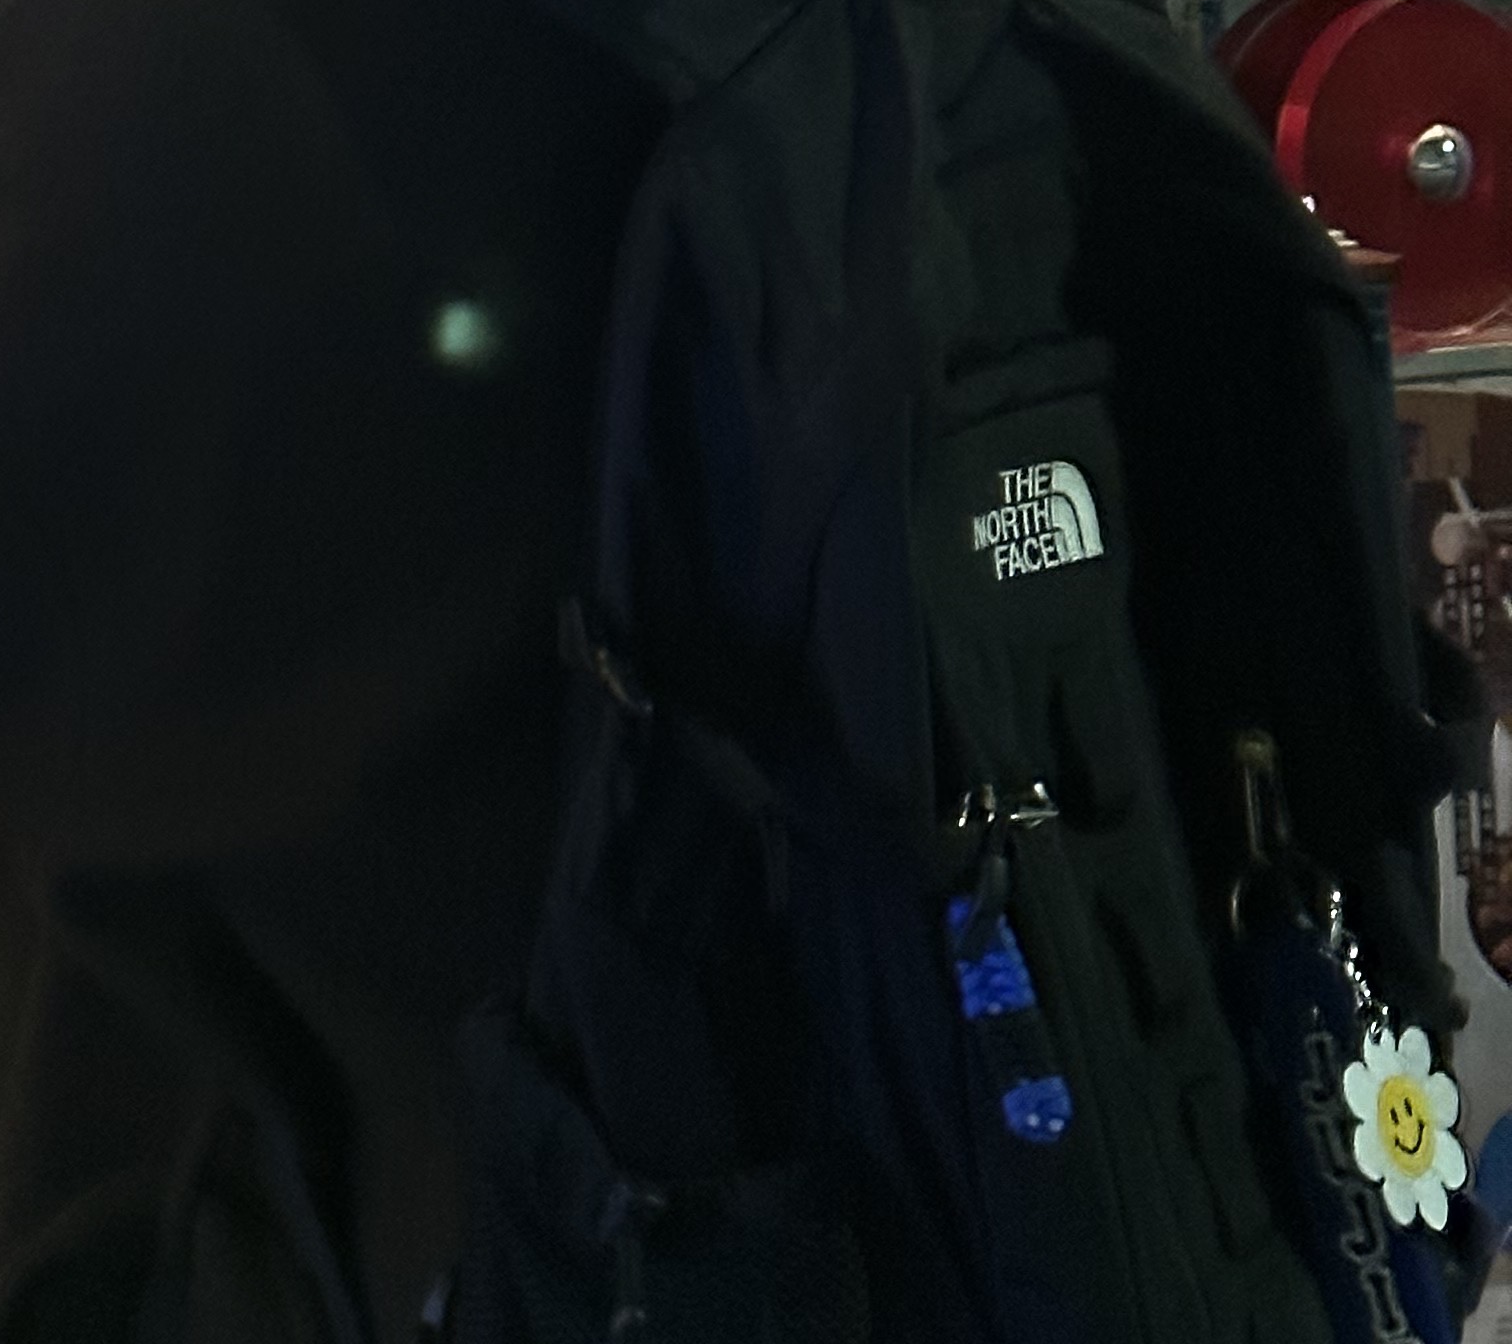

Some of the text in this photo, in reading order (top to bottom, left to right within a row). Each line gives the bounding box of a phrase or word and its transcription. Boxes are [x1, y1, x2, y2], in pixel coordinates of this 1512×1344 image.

[999, 464, 1054, 504] THE
[972, 497, 1052, 551] NORTH
[994, 534, 1059, 581] FACE
